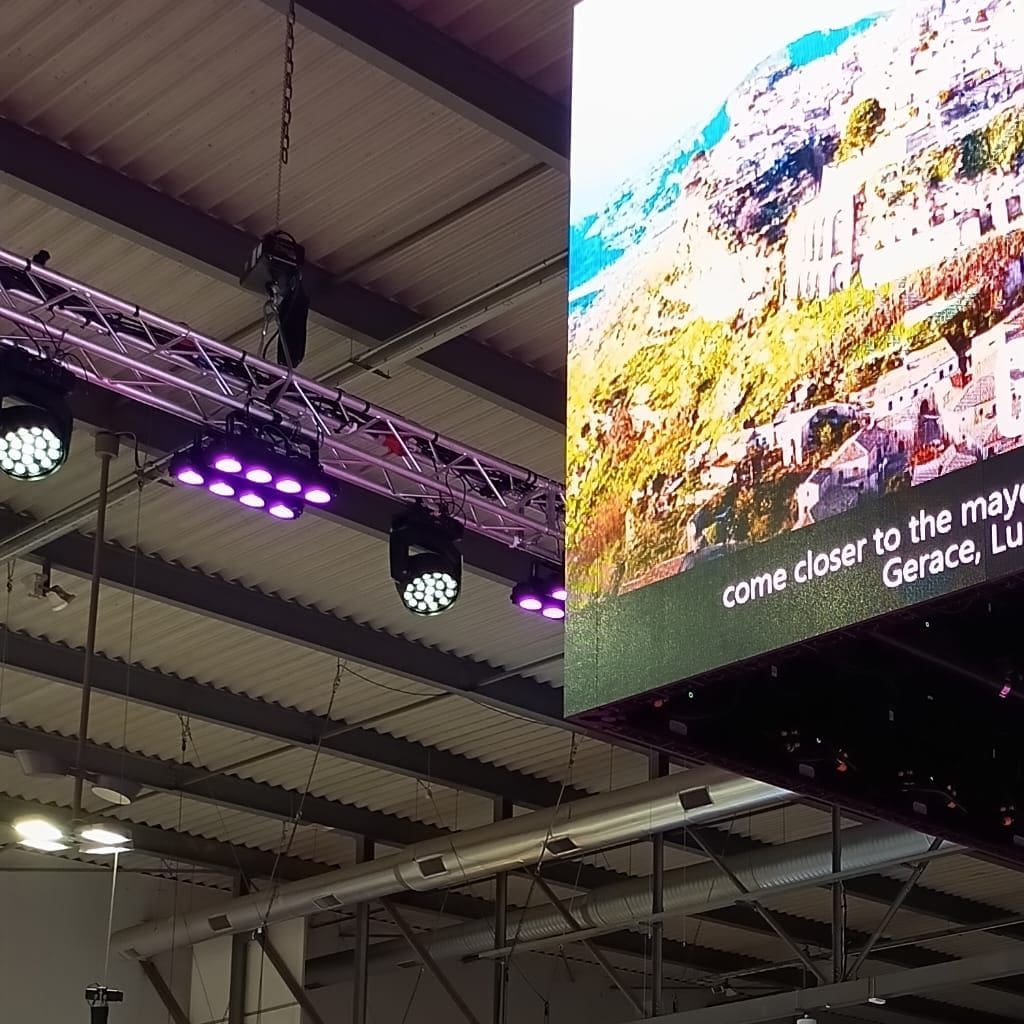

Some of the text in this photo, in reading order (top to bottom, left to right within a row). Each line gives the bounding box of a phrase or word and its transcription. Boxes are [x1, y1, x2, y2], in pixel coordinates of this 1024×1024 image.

[722, 567, 788, 608] come
[793, 537, 868, 584] closer
[872, 527, 901, 556] to
[908, 509, 953, 544] the
[882, 539, 981, 588] Gerace,
